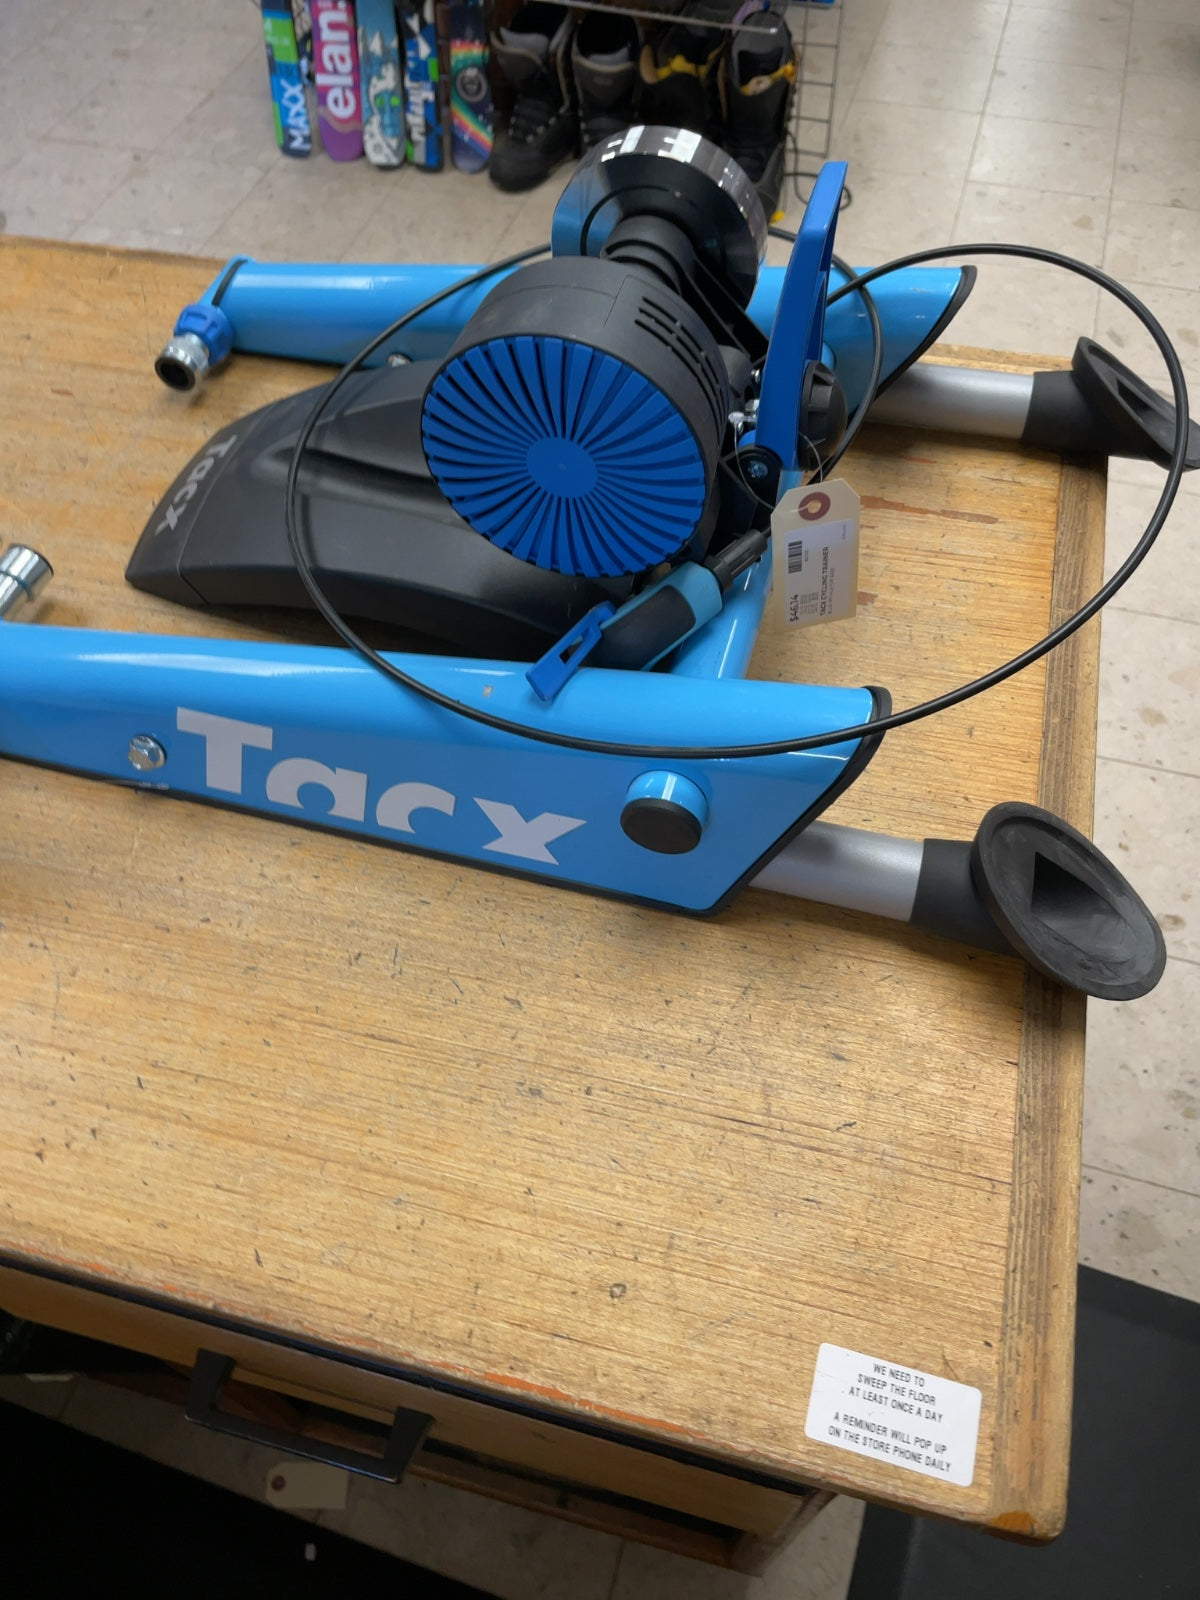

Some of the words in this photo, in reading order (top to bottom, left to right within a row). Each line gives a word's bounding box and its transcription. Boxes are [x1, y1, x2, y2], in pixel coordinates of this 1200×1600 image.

[279, 78, 312, 151] MAXX
[154, 434, 238, 537] Tacx
[820, 575, 828, 600] CYCLING
[176, 706, 588, 866] Tacx
[857, 1373, 887, 1390] SWEEP
[890, 1383, 905, 1396] THE
[908, 1389, 936, 1405] FLOOR
[873, 1363, 887, 1376] WE
[889, 1368, 911, 1382] NEED
[914, 1375, 925, 1387] TO
[848, 1386, 860, 1397] AT
[862, 1390, 889, 1406] LEAST
[891, 1399, 914, 1414] ONCE
[916, 1407, 922, 1416] A
[924, 1409, 944, 1423] DAY
[828, 1425, 841, 1438] ON
[843, 1430, 860, 1444] THE
[862, 1436, 890, 1454] STORE
[892, 1445, 922, 1464] PHONE
[924, 1456, 952, 1473] DAILY
[833, 1412, 840, 1422] A
[843, 1414, 888, 1437] REMINDER
[891, 1429, 912, 1445] WILL
[913, 1436, 932, 1451] POP
[934, 1443, 948, 1455] UP
